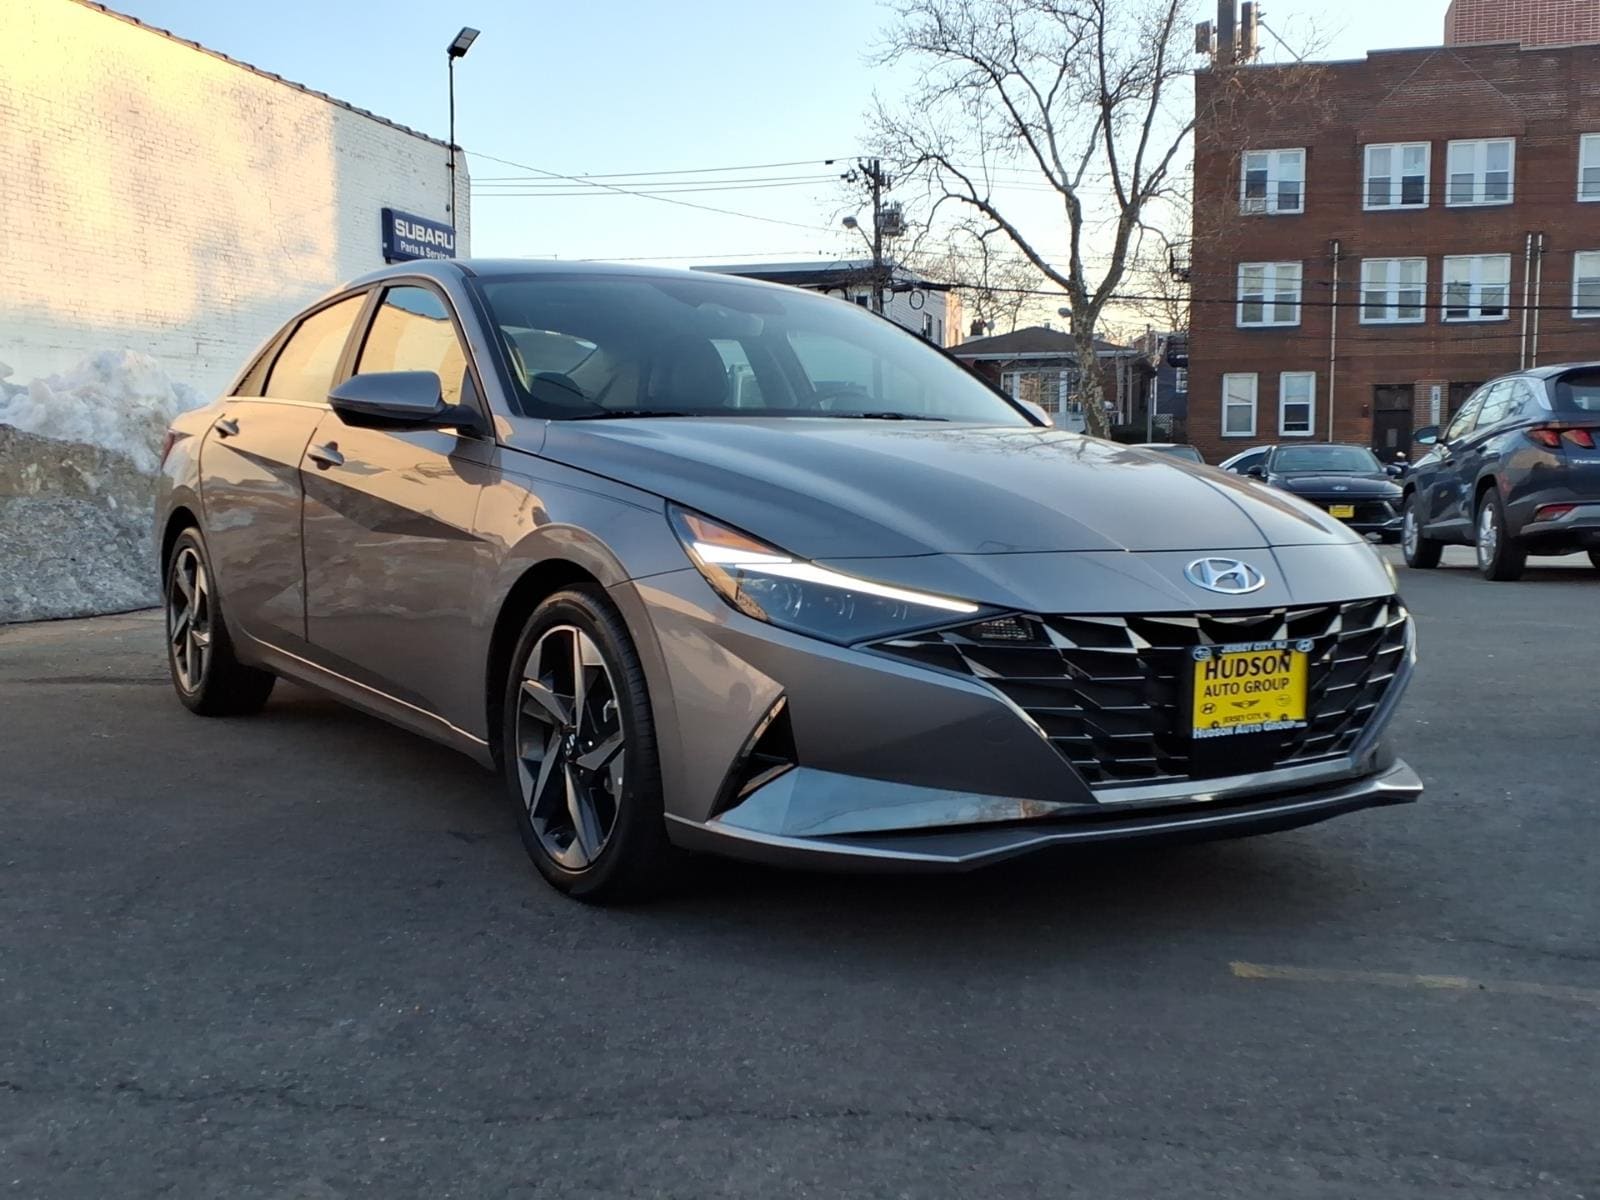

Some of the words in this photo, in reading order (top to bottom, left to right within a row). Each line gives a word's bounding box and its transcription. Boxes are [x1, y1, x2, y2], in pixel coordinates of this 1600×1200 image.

[395, 219, 454, 249] SUBARU
[400, 240, 419, 255] Parts
[420, 246, 425, 256] &
[1205, 654, 1291, 680] HUDSON
[1204, 683, 1240, 697] AUTO
[1243, 677, 1290, 694] GROUP
